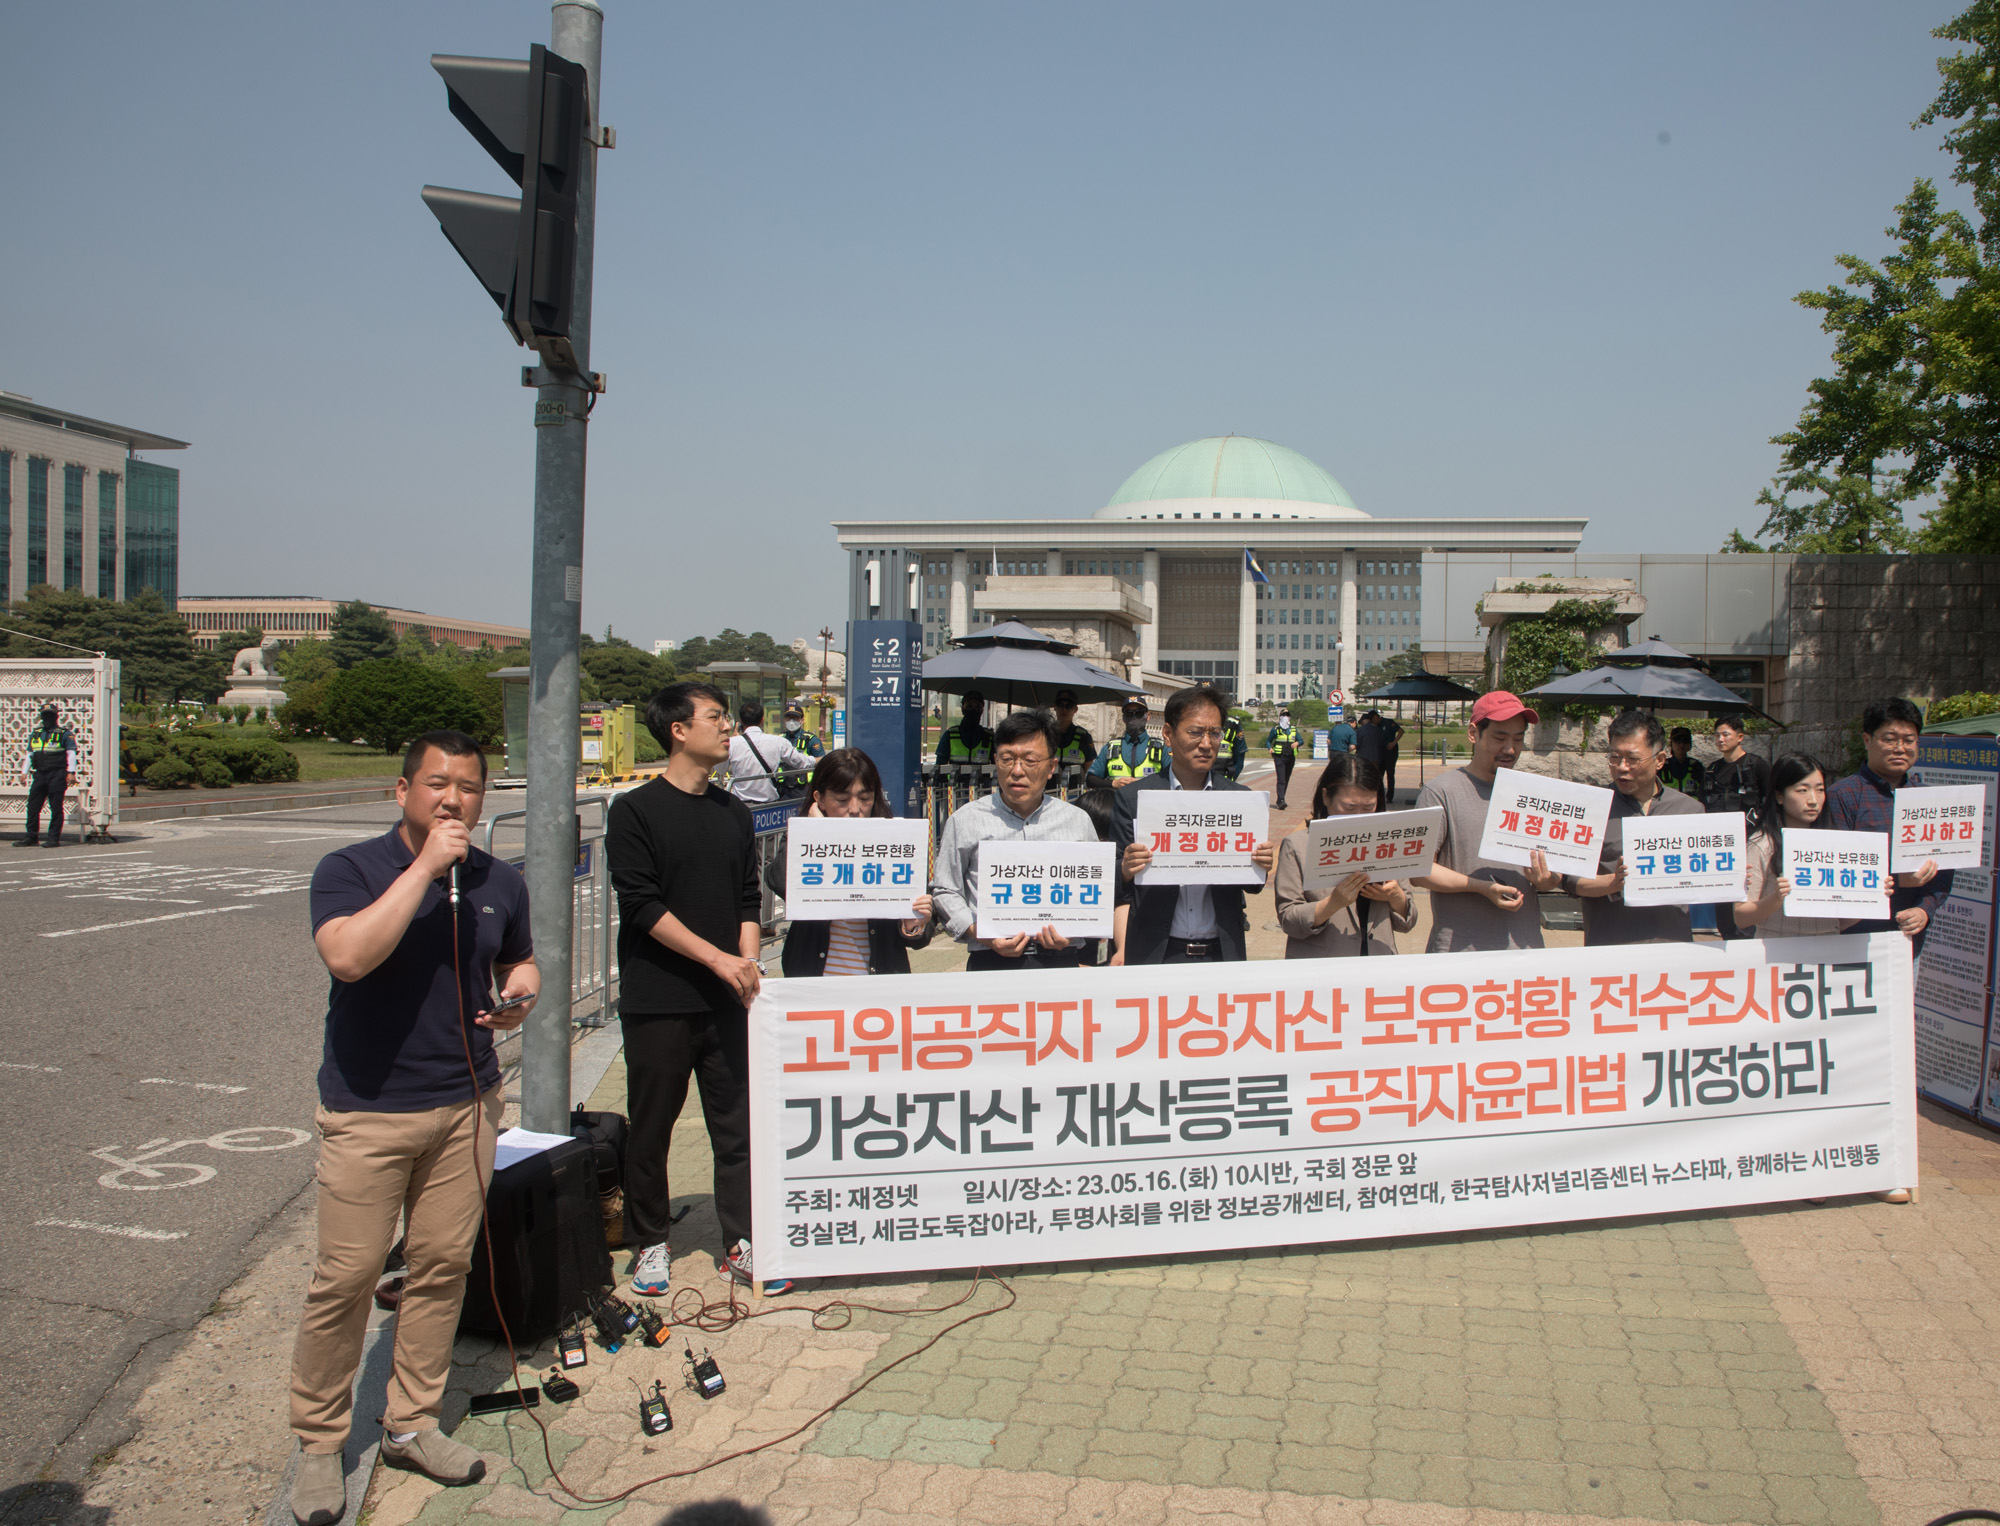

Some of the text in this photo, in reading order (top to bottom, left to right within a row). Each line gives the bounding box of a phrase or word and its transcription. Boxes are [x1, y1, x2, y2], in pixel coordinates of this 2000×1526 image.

[888, 638, 900, 656] 2
[887, 677, 899, 695] 7
[1516, 795, 1586, 820] 공직자윤리법
[1902, 806, 1976, 820] 가상자산 보유현황
[755, 810, 782, 829] POLICE
[1165, 814, 1242, 827] 공직자윤리법
[1320, 826, 1429, 847] 가상자산 보유현황
[1634, 835, 1734, 850] 가상자산 이해충돌
[801, 844, 915, 858] 가상자산 보유현황
[1793, 851, 1879, 865] 가상자산 보유현황
[991, 865, 1102, 879] 가상자산 이해충돌
[783, 999, 1101, 1073] 고위공직자
[1116, 988, 1349, 1059] 가상자산
[1362, 976, 1576, 1045] 보유현황
[1591, 962, 1877, 1034] 전수조사하고
[785, 1087, 1040, 1161] 가상자산
[1056, 1074, 1292, 1147] 재산등록
[1307, 1053, 1627, 1134] 공직자윤리법
[1642, 1038, 1835, 1107] 개정하라
[964, 1152, 1417, 1204] 일시/장소: 23.05.16.(화) 10시반, 국회 정문 앞
[785, 1184, 918, 1214] 주최: 재정넷
[787, 1144, 1880, 1247] 경실련, 세금도둑잡아라, 투명사회를 위한 정보공개센터, 참여연대, 한국탐사저널리즘센터 뉴스타파, 함께하는 시민행동
